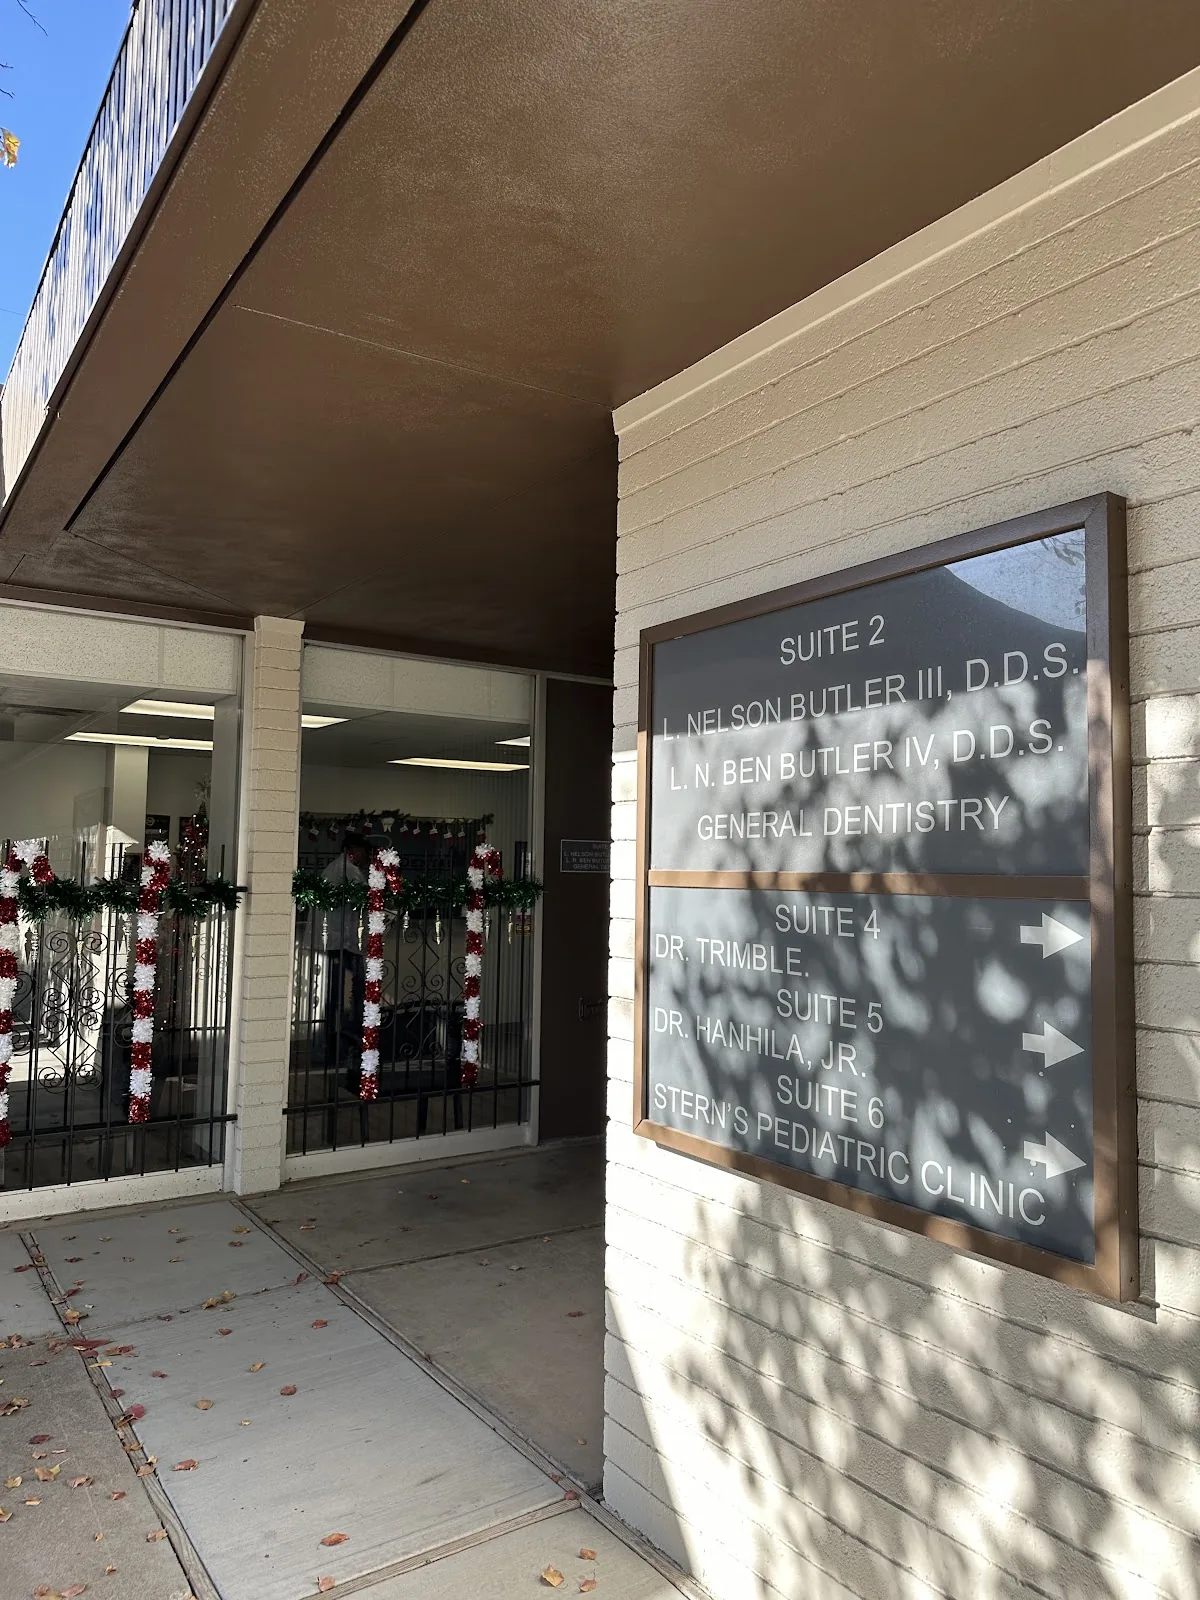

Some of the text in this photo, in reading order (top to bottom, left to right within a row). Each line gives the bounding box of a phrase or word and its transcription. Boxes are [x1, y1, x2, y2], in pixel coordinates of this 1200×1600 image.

[780, 614, 885, 665] SUITE 2
[663, 642, 1079, 741] L. NELSON BUTLER III, D.D.S.
[671, 719, 1065, 791] L. N. BEN BUTLER IV, D.D.S.
[698, 795, 1010, 841] GENERAL DENTISTRY
[775, 904, 881, 940] SUITE 4
[655, 934, 809, 977] DR. TRIMBLE.
[776, 989, 883, 1034] SUITE 5
[654, 1007, 867, 1078] DR. HANHILA, JR.
[776, 1074, 885, 1130] SUITE 6
[654, 1083, 1046, 1226] STERN'S PEDIATRIC CLINIC
